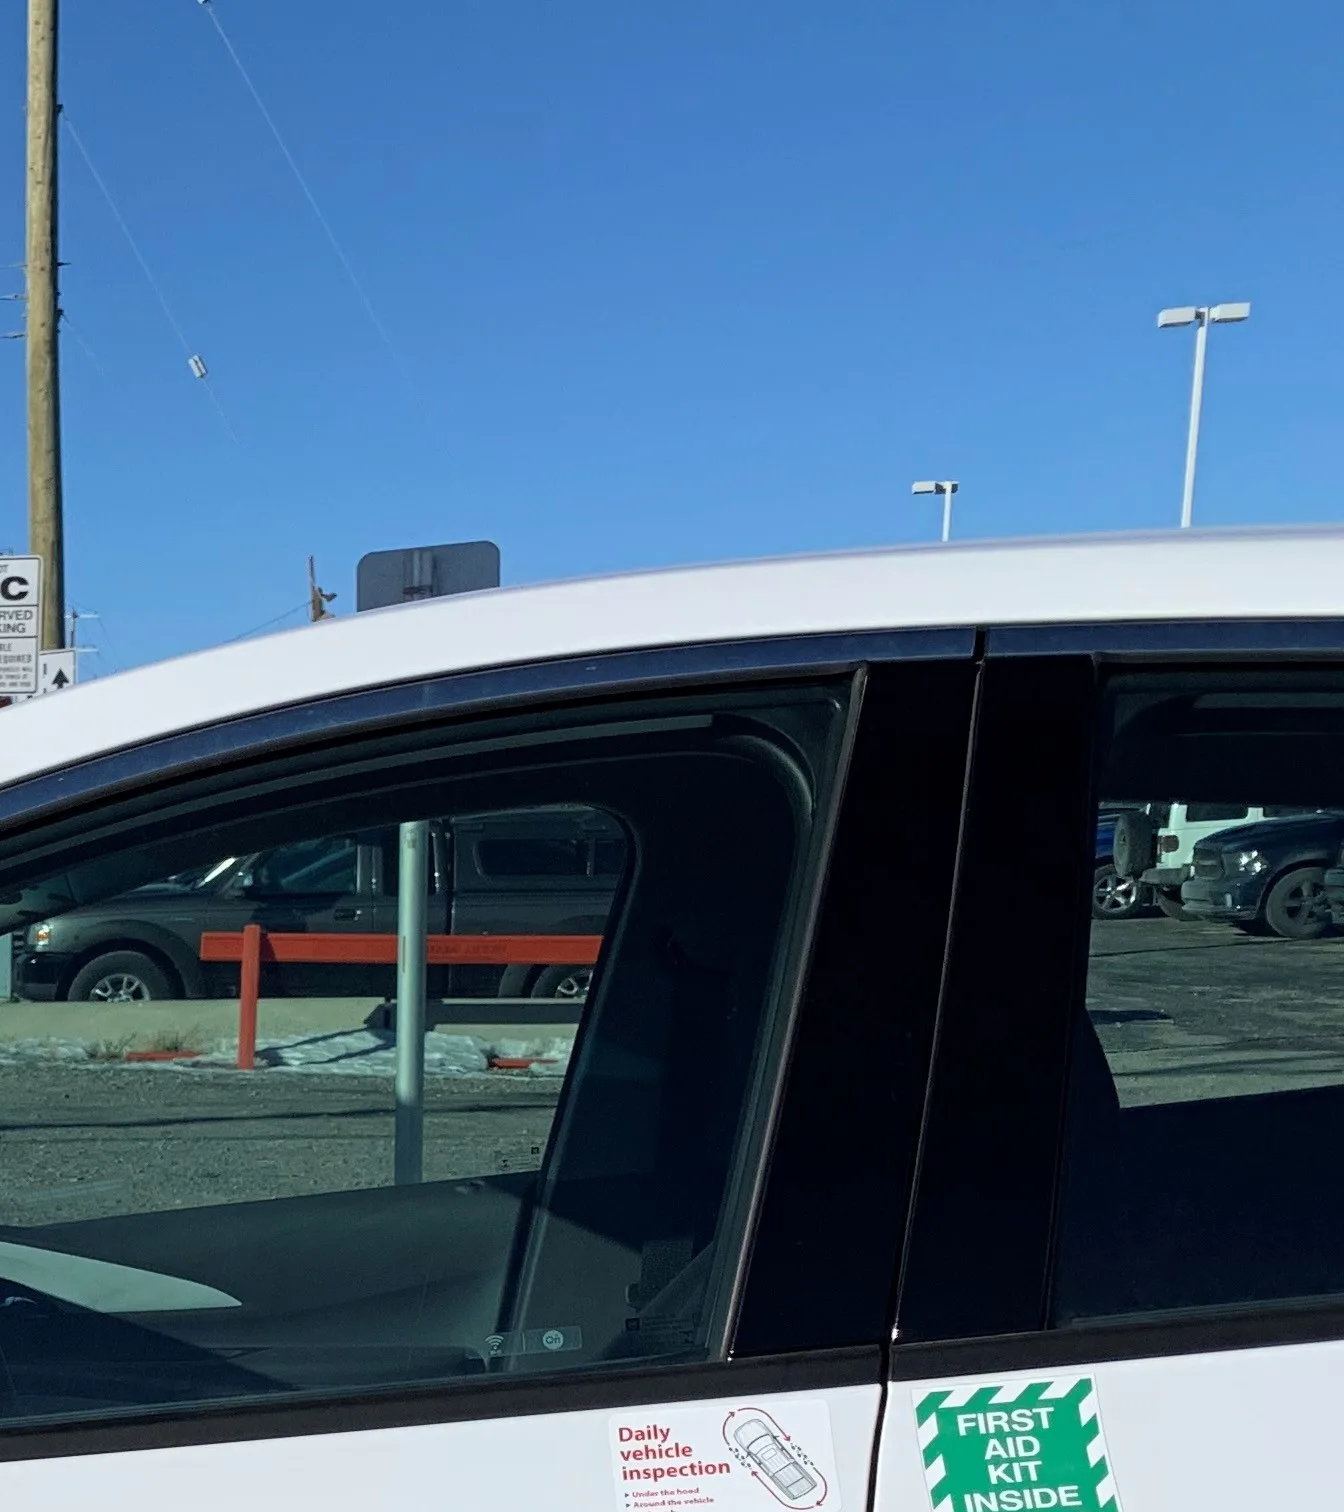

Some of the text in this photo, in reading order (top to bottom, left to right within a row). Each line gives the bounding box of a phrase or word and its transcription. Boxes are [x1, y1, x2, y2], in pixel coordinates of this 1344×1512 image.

[955, 1406, 1055, 1437] FIRST
[618, 1424, 671, 1444] Daily
[619, 1442, 693, 1462] vehicle
[983, 1434, 1041, 1461] AID
[622, 1460, 731, 1483] inspection
[987, 1460, 1042, 1485] KIT
[632, 1487, 700, 1498] Under the hood
[633, 1500, 666, 1508] Around
